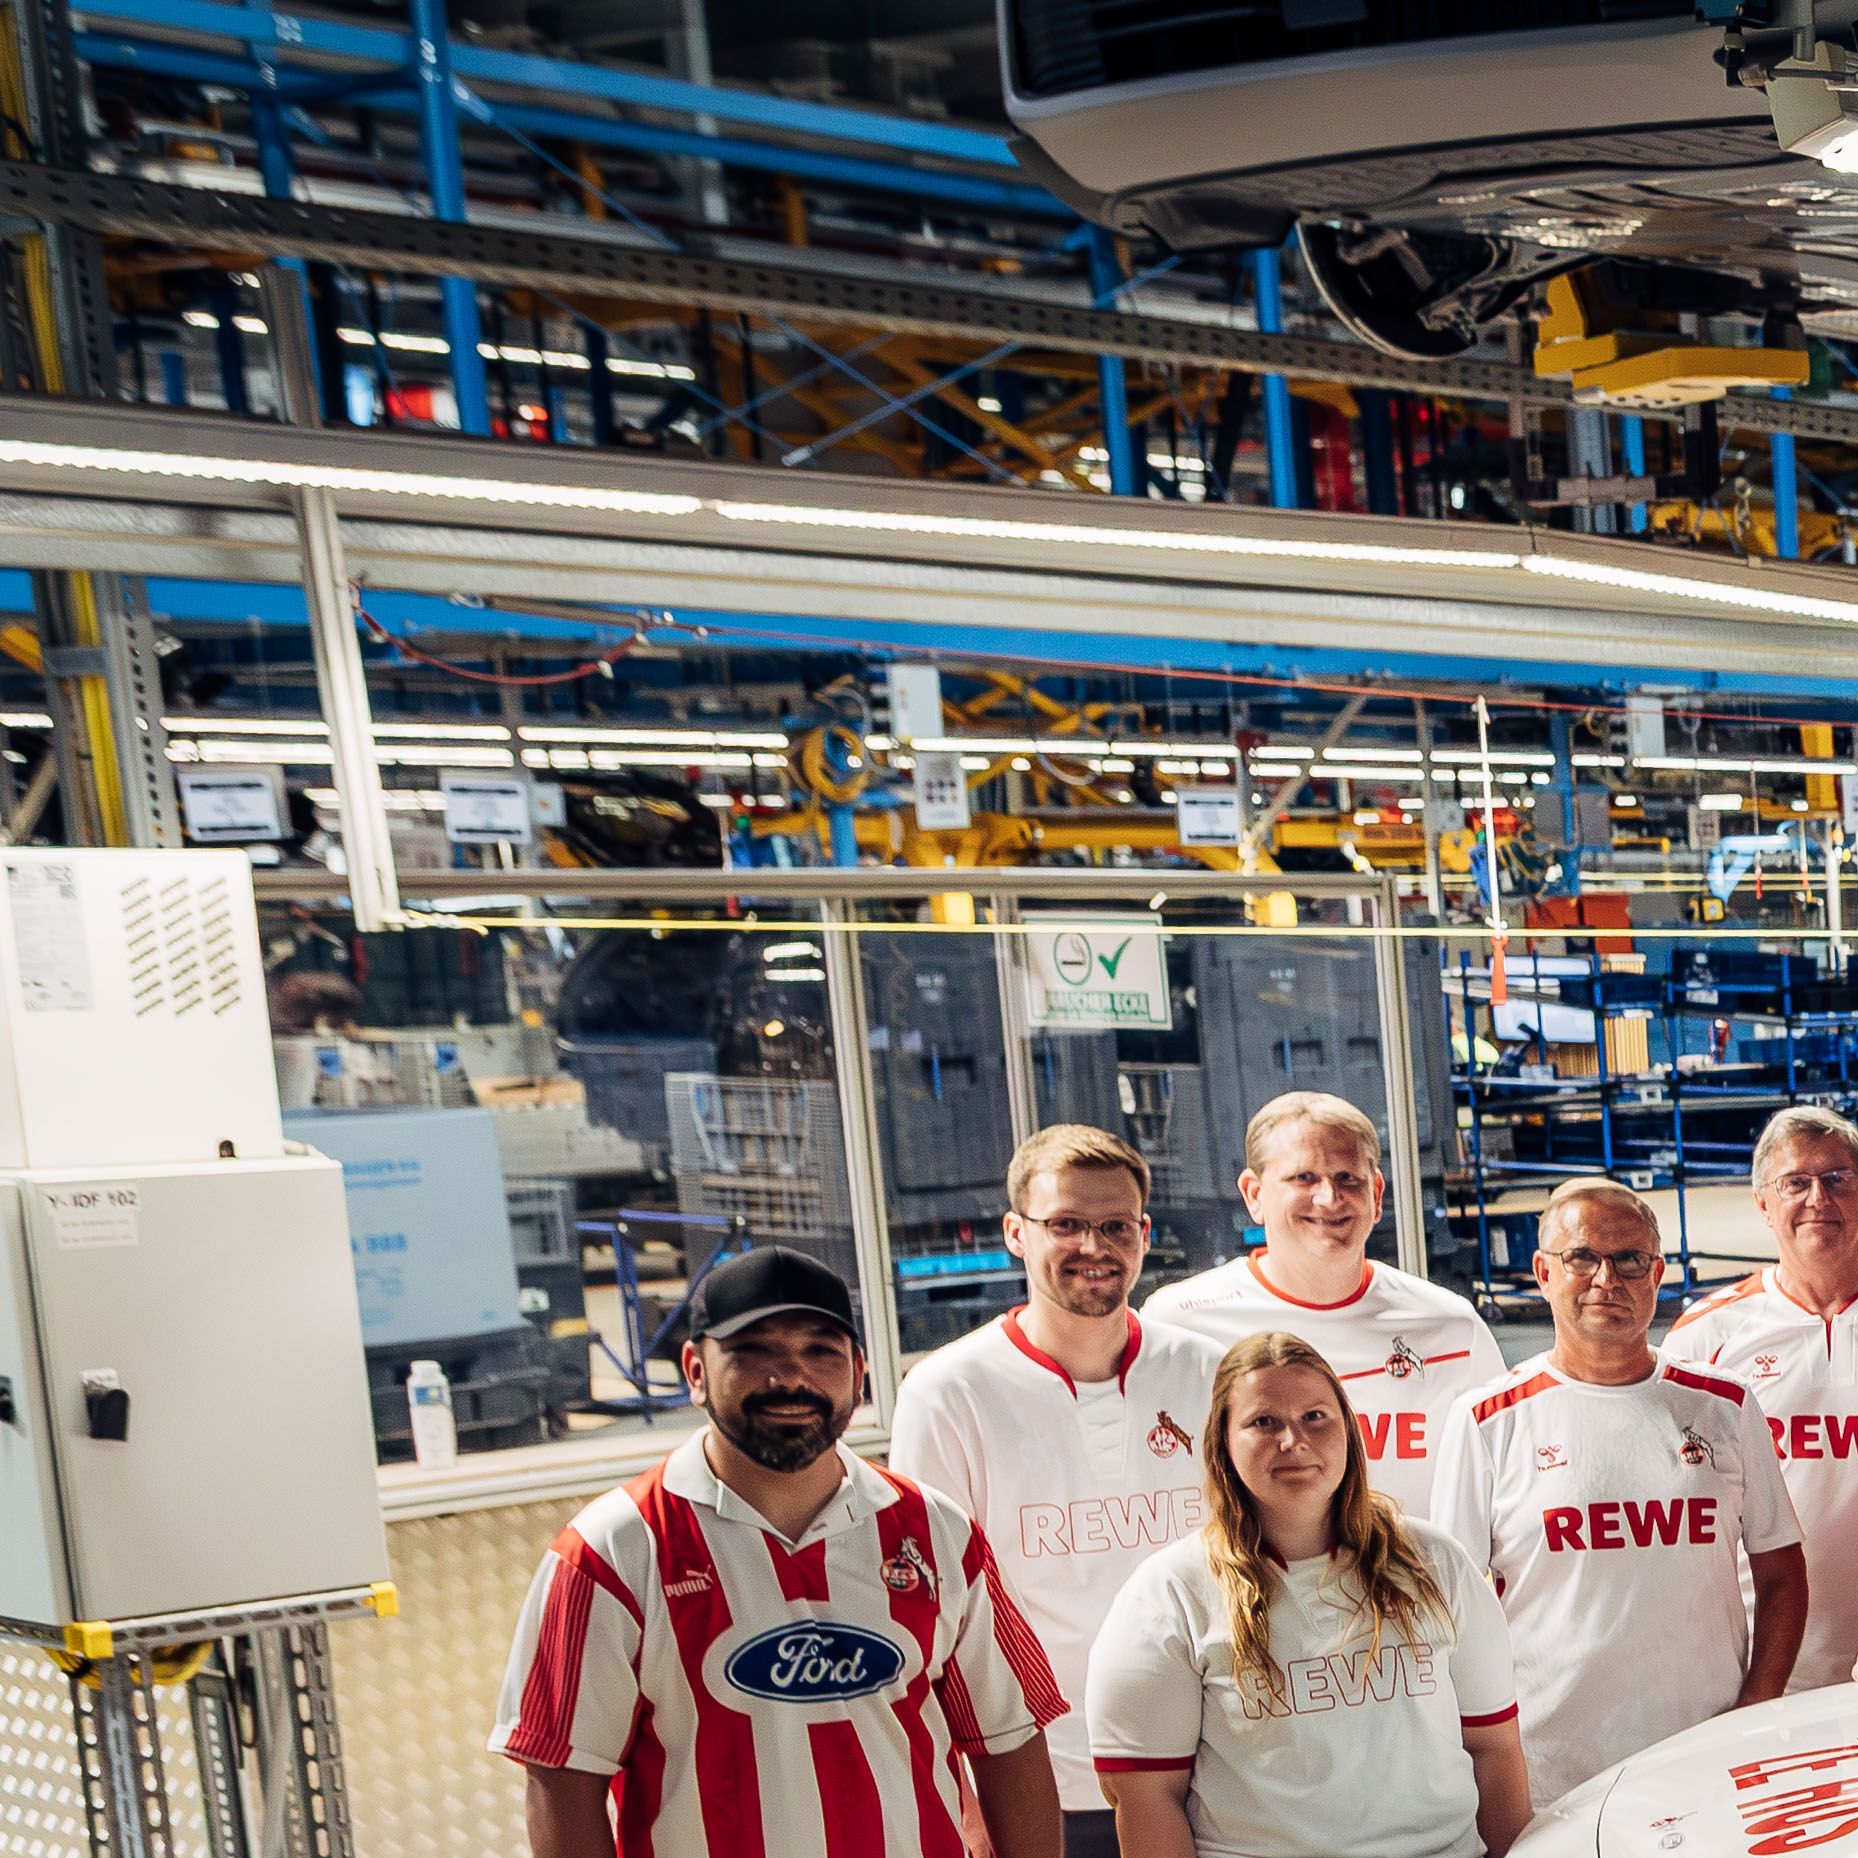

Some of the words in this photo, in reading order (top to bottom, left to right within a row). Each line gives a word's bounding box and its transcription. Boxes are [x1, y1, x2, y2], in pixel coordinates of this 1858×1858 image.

[1020, 1488, 1201, 1558] REWE
[1543, 1498, 1717, 1552] REWE
[770, 1634, 867, 1688] Ford
[1244, 1645, 1437, 1720] REWE
